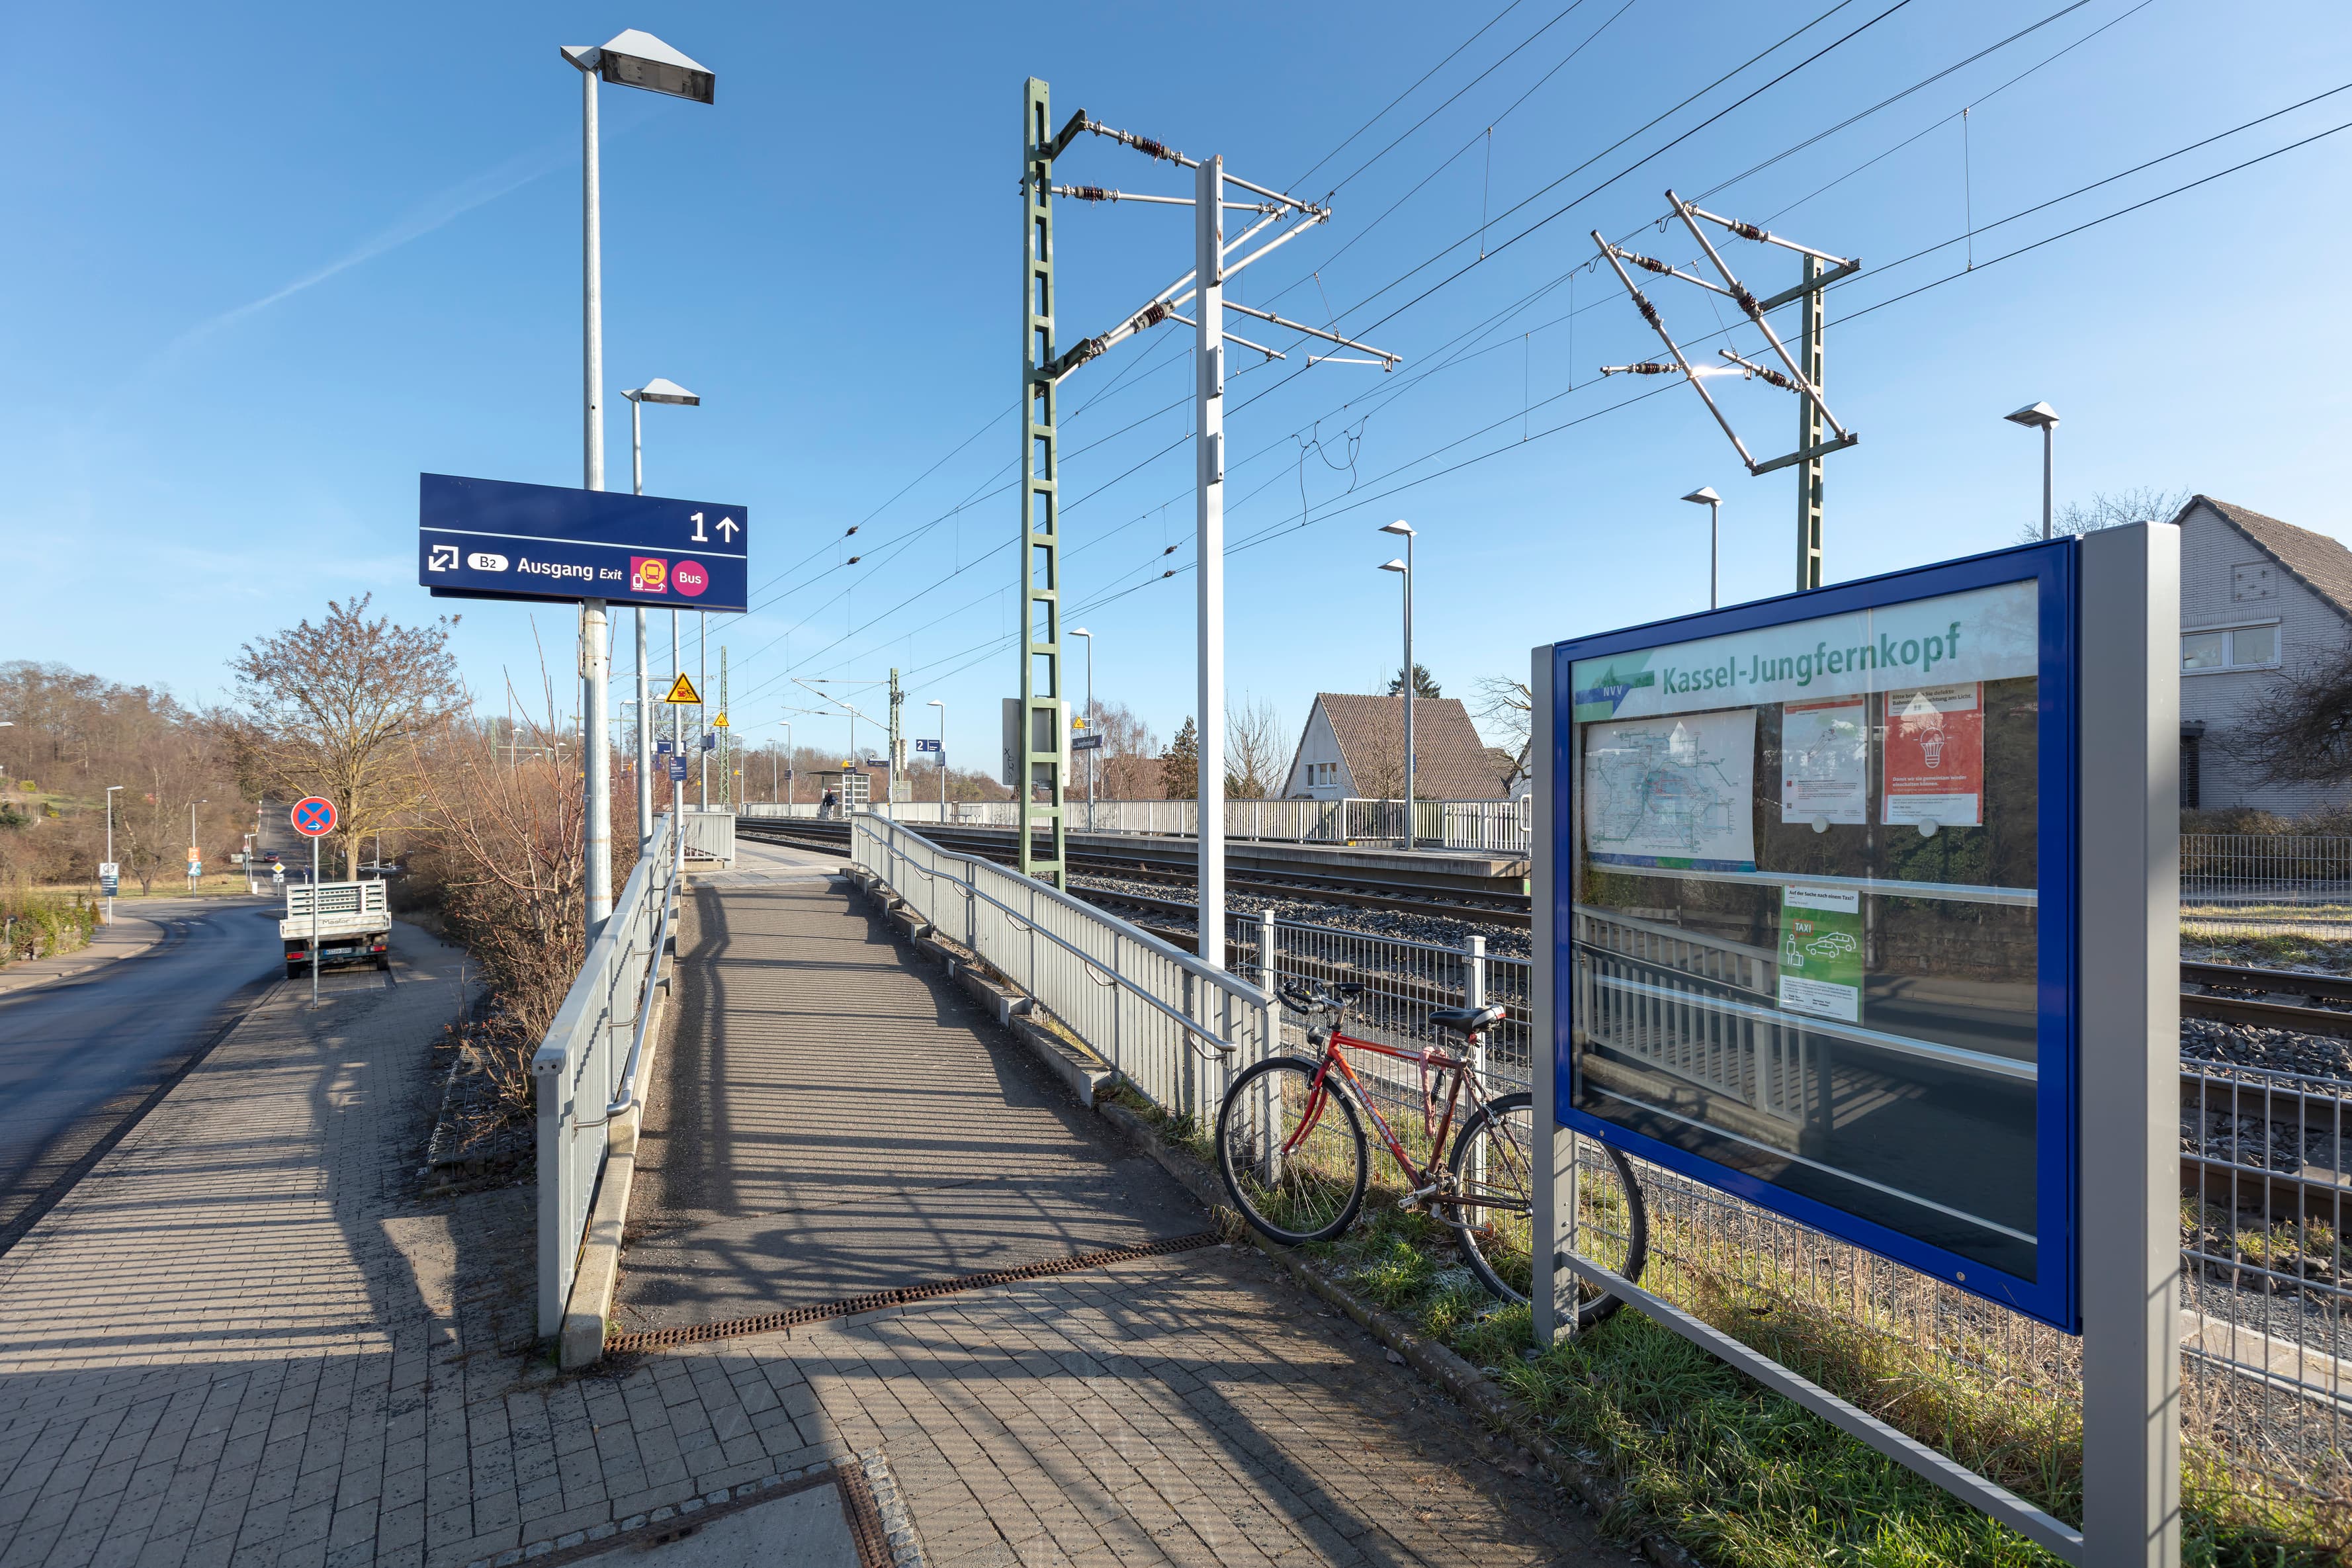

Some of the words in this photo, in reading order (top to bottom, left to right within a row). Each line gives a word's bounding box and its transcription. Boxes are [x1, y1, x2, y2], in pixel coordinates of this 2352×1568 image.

[689, 511, 709, 543] 1
[479, 556, 497, 569] B2
[517, 557, 593, 581] Ausgang
[599, 568, 623, 581] Exit
[679, 571, 702, 585] Bus
[1663, 621, 1961, 695] Kassel-Jungfernkopf
[1603, 685, 1622, 697] NVV
[917, 740, 924, 750] 2
[1795, 922, 1811, 934] TAXI
[1350, 1078, 1395, 1145] PEUGEOT
